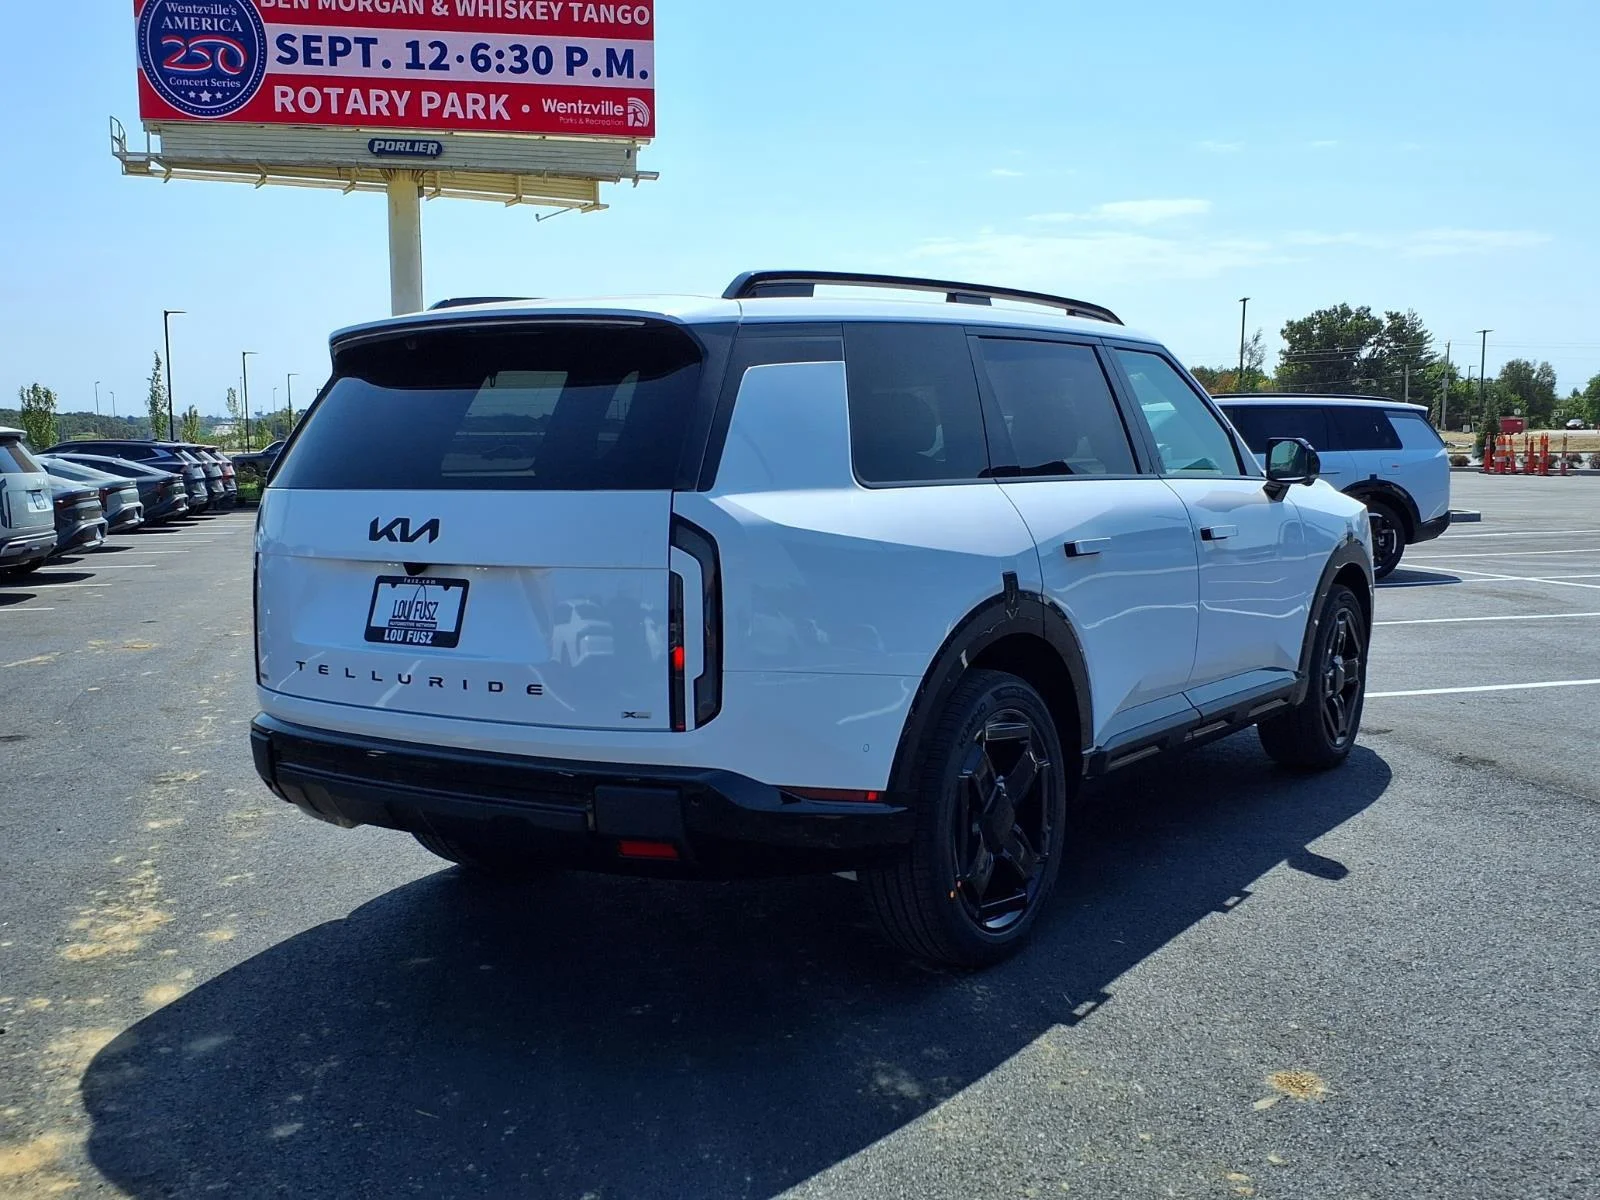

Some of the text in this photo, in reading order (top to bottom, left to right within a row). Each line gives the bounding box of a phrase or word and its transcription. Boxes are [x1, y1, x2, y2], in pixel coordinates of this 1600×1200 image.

[165, 2, 237, 15] Wentzville's
[317, 0, 424, 15] MORGAN
[431, 0, 449, 16] &
[455, 0, 565, 21] WHISKEY
[568, 3, 650, 25] TANGO
[161, 16, 243, 32] AMERICA
[161, 35, 248, 74] 250
[275, 33, 392, 69] SEPT.
[565, 46, 649, 80] P.M.
[169, 77, 241, 88] Concert Series
[274, 85, 511, 121] ROTARY PARK
[541, 98, 625, 116] Wentzville
[585, 118, 624, 126] Recreation
[372, 139, 439, 155] PORLIER
[368, 516, 440, 544] KIA
[392, 599, 439, 620] LOU FUSZ
[384, 629, 434, 644] LOU FUSZ
[295, 660, 544, 696] TELLURIDE
